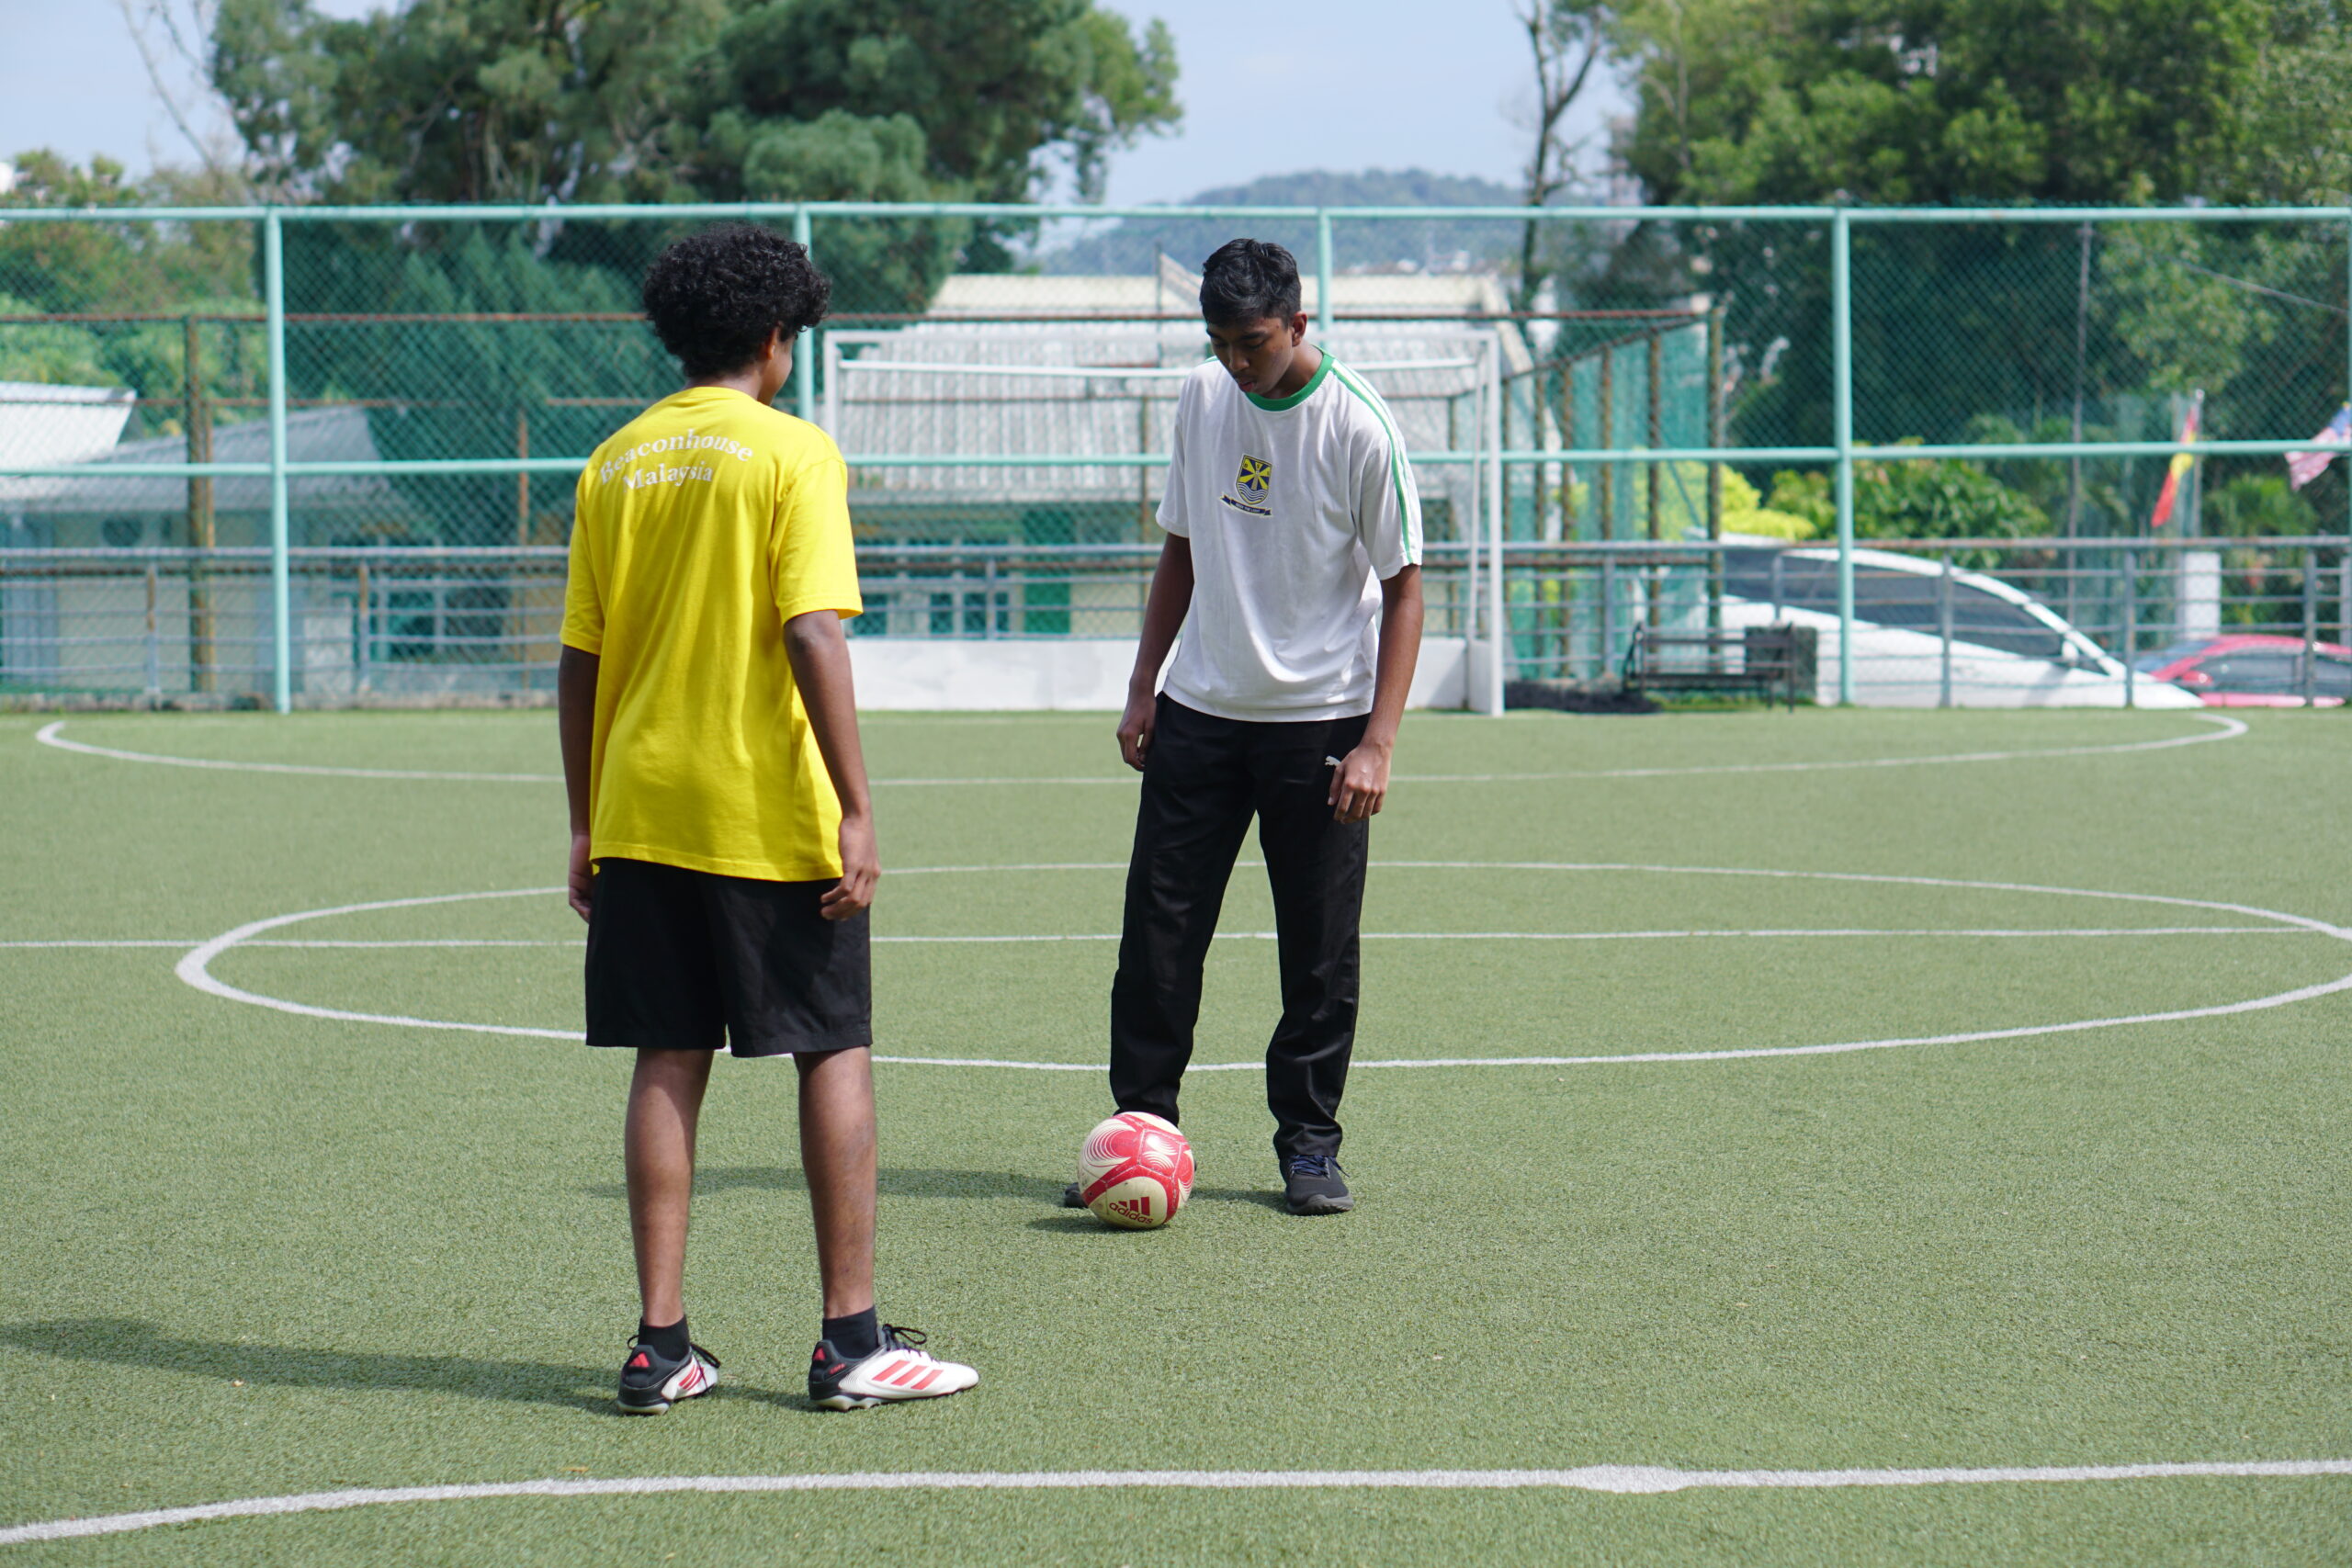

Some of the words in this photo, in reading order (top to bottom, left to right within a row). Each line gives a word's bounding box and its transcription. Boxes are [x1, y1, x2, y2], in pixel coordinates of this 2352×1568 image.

[600, 429, 753, 485] Beaconhouse
[623, 461, 713, 491] Malaysia
[1109, 1202, 1154, 1224] adidas
